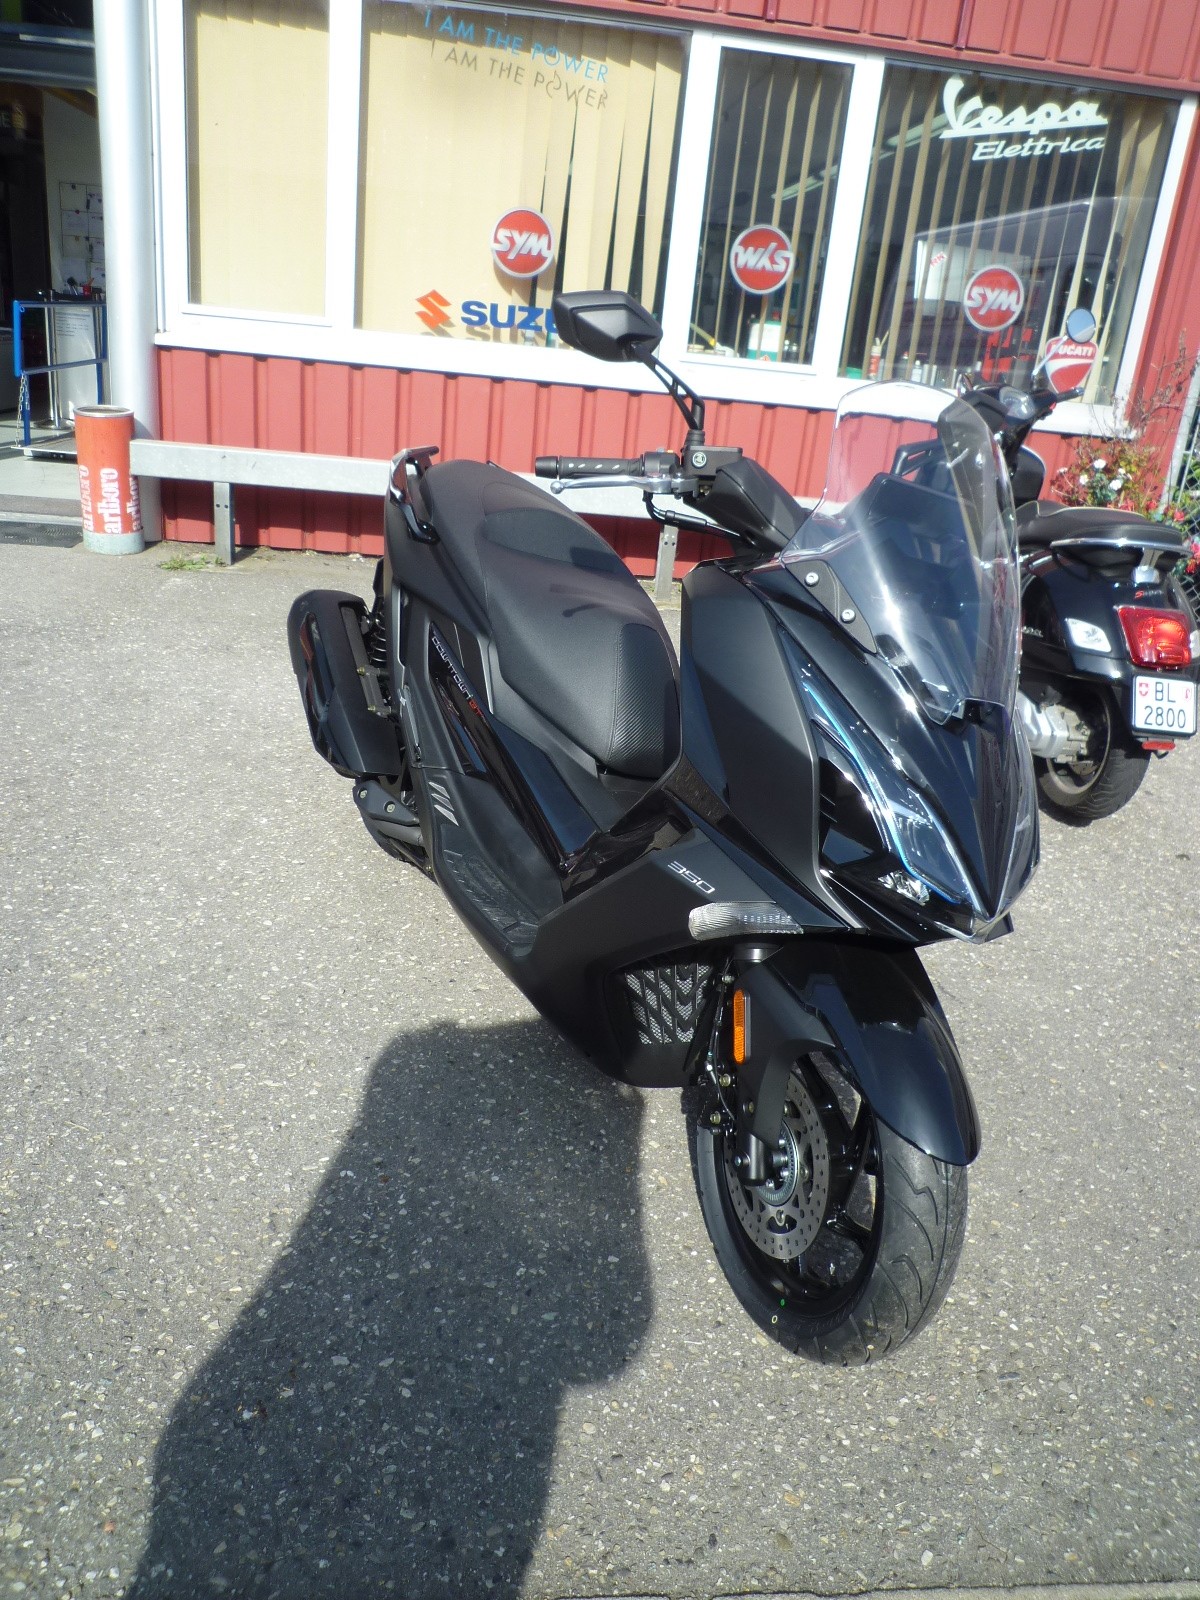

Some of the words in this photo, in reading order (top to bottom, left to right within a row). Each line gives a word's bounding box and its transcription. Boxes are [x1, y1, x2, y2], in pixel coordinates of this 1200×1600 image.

[423, 9, 431, 28] I
[438, 16, 475, 42] AM
[485, 27, 523, 56] THE
[531, 42, 609, 83] POWER
[939, 75, 1109, 139] Vespa
[971, 136, 1106, 161] Elettrica
[491, 228, 551, 260] SYM
[965, 286, 1018, 315] SYM
[1154, 681, 1177, 703] BL
[1143, 705, 1187, 729] 2800
[667, 861, 716, 894] 350
